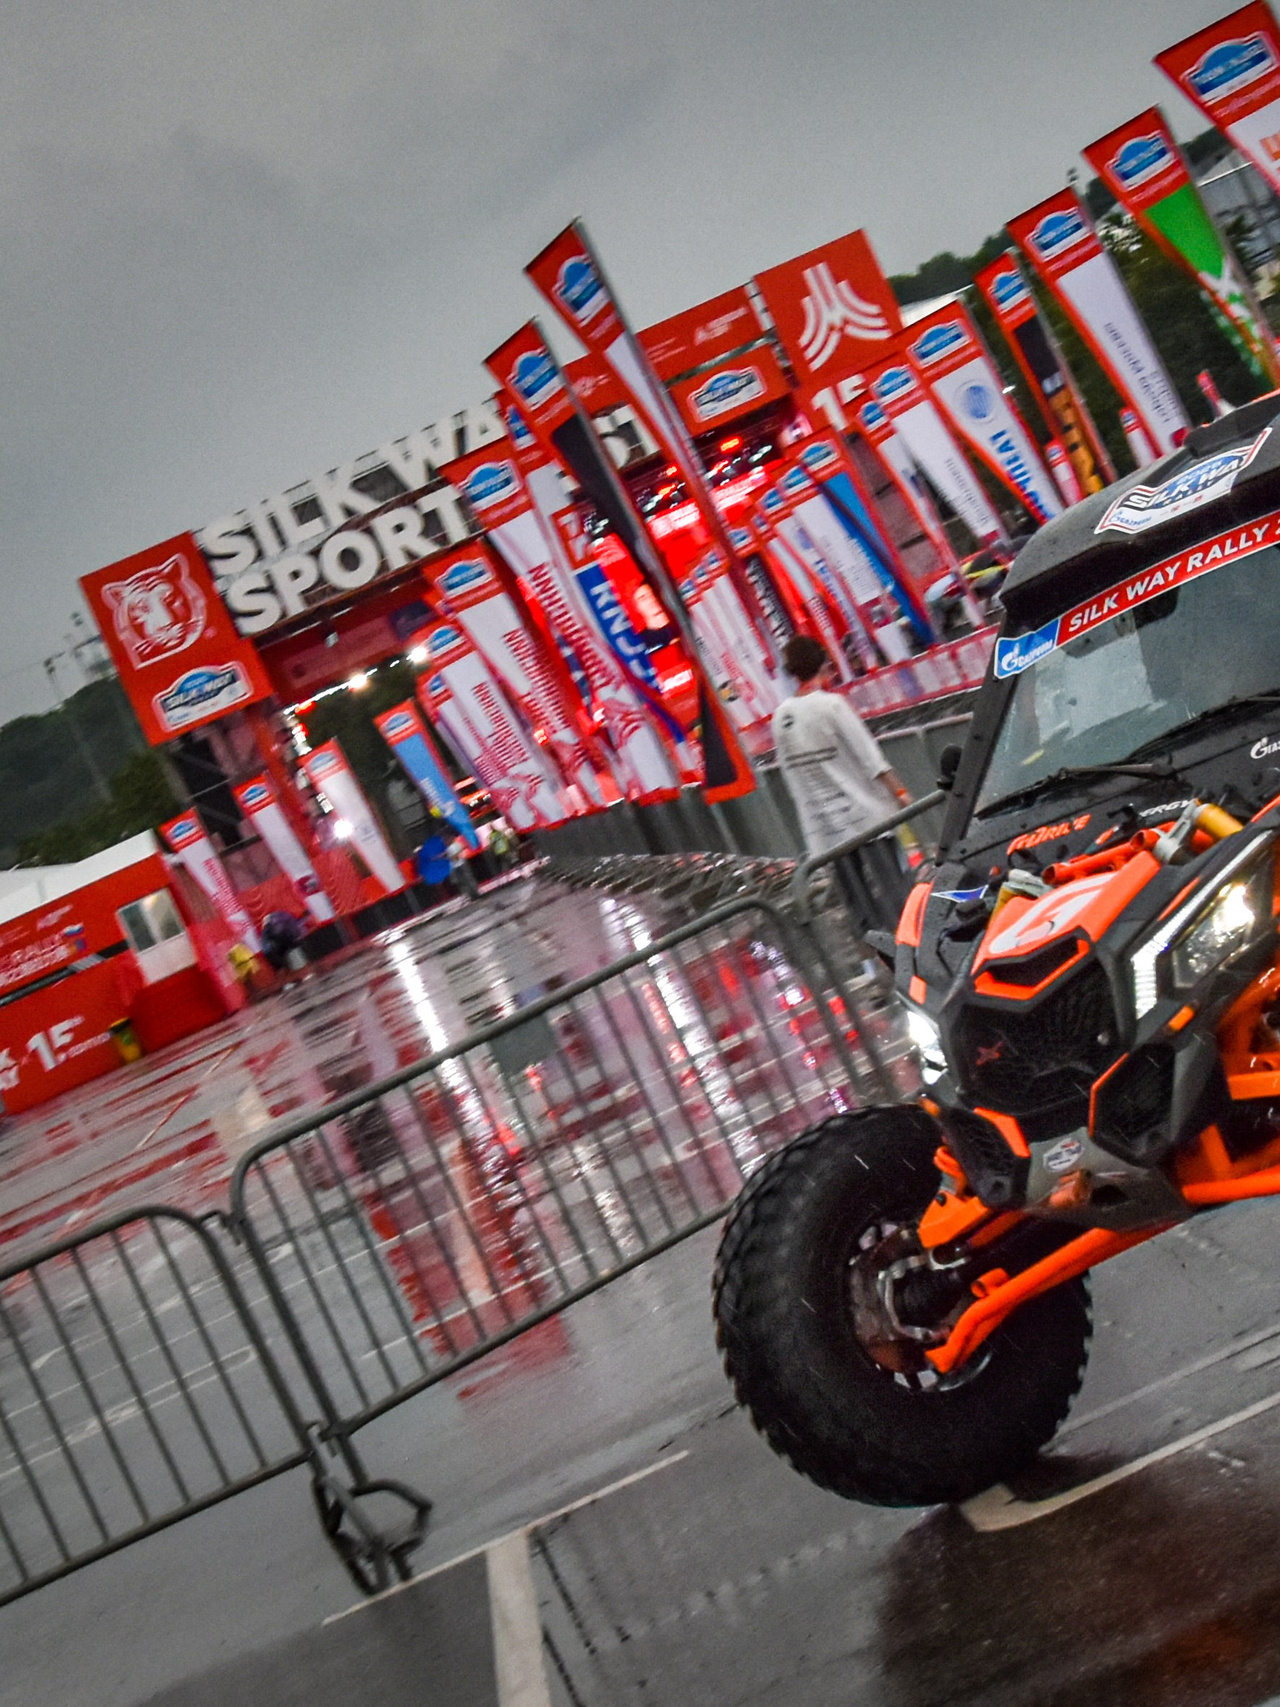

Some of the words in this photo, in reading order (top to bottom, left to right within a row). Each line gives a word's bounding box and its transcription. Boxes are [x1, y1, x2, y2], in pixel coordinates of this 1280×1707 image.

[200, 462, 362, 577] SILK
[378, 403, 510, 493] WA
[225, 487, 484, 637] SPORT
[1068, 592, 1120, 632] SILK
[1126, 561, 1182, 600] WAY
[1186, 522, 1271, 573] RALLY
